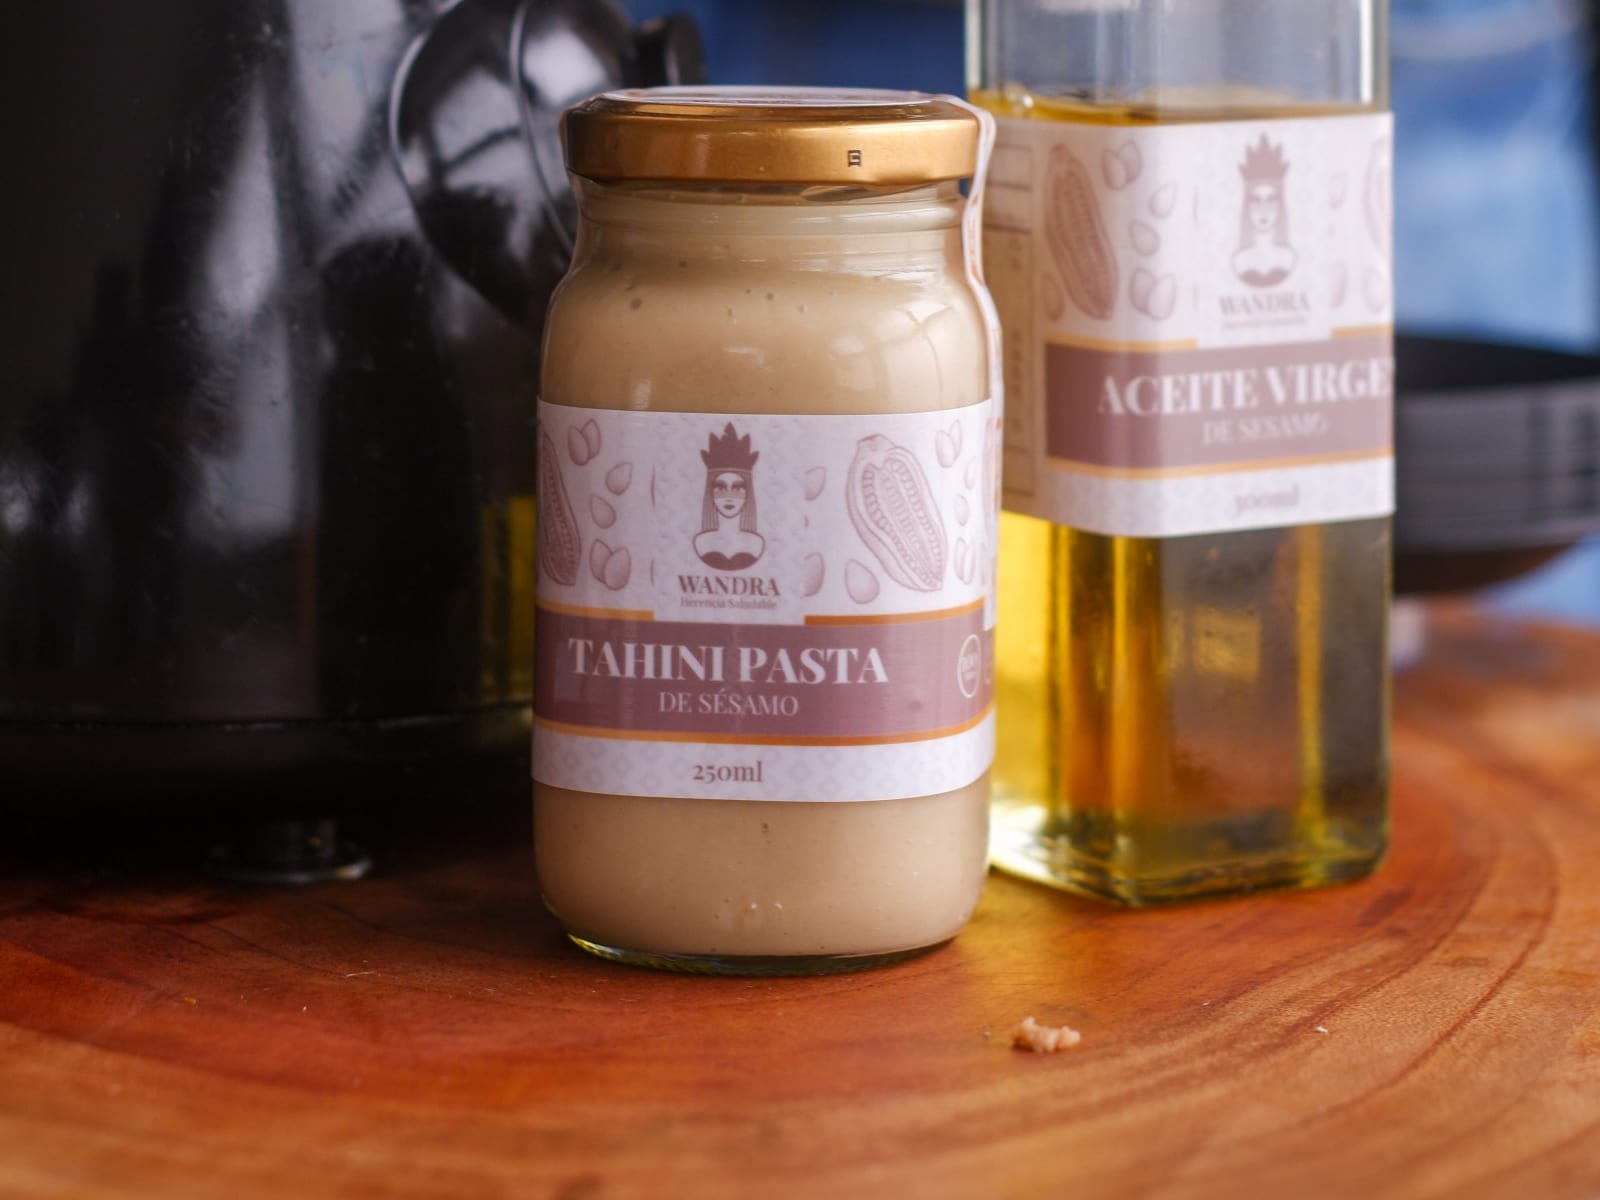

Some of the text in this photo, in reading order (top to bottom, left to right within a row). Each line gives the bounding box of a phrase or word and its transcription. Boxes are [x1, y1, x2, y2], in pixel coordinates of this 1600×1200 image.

[1217, 292, 1311, 315] WANDRA
[1097, 367, 1260, 416] ACEITE
[1202, 419, 1233, 445] DE
[677, 575, 781, 597] WANDRA
[568, 637, 890, 685] TAHINI PASTA
[658, 687, 799, 717] DE SÉSAMO
[692, 760, 763, 783] 250ml
